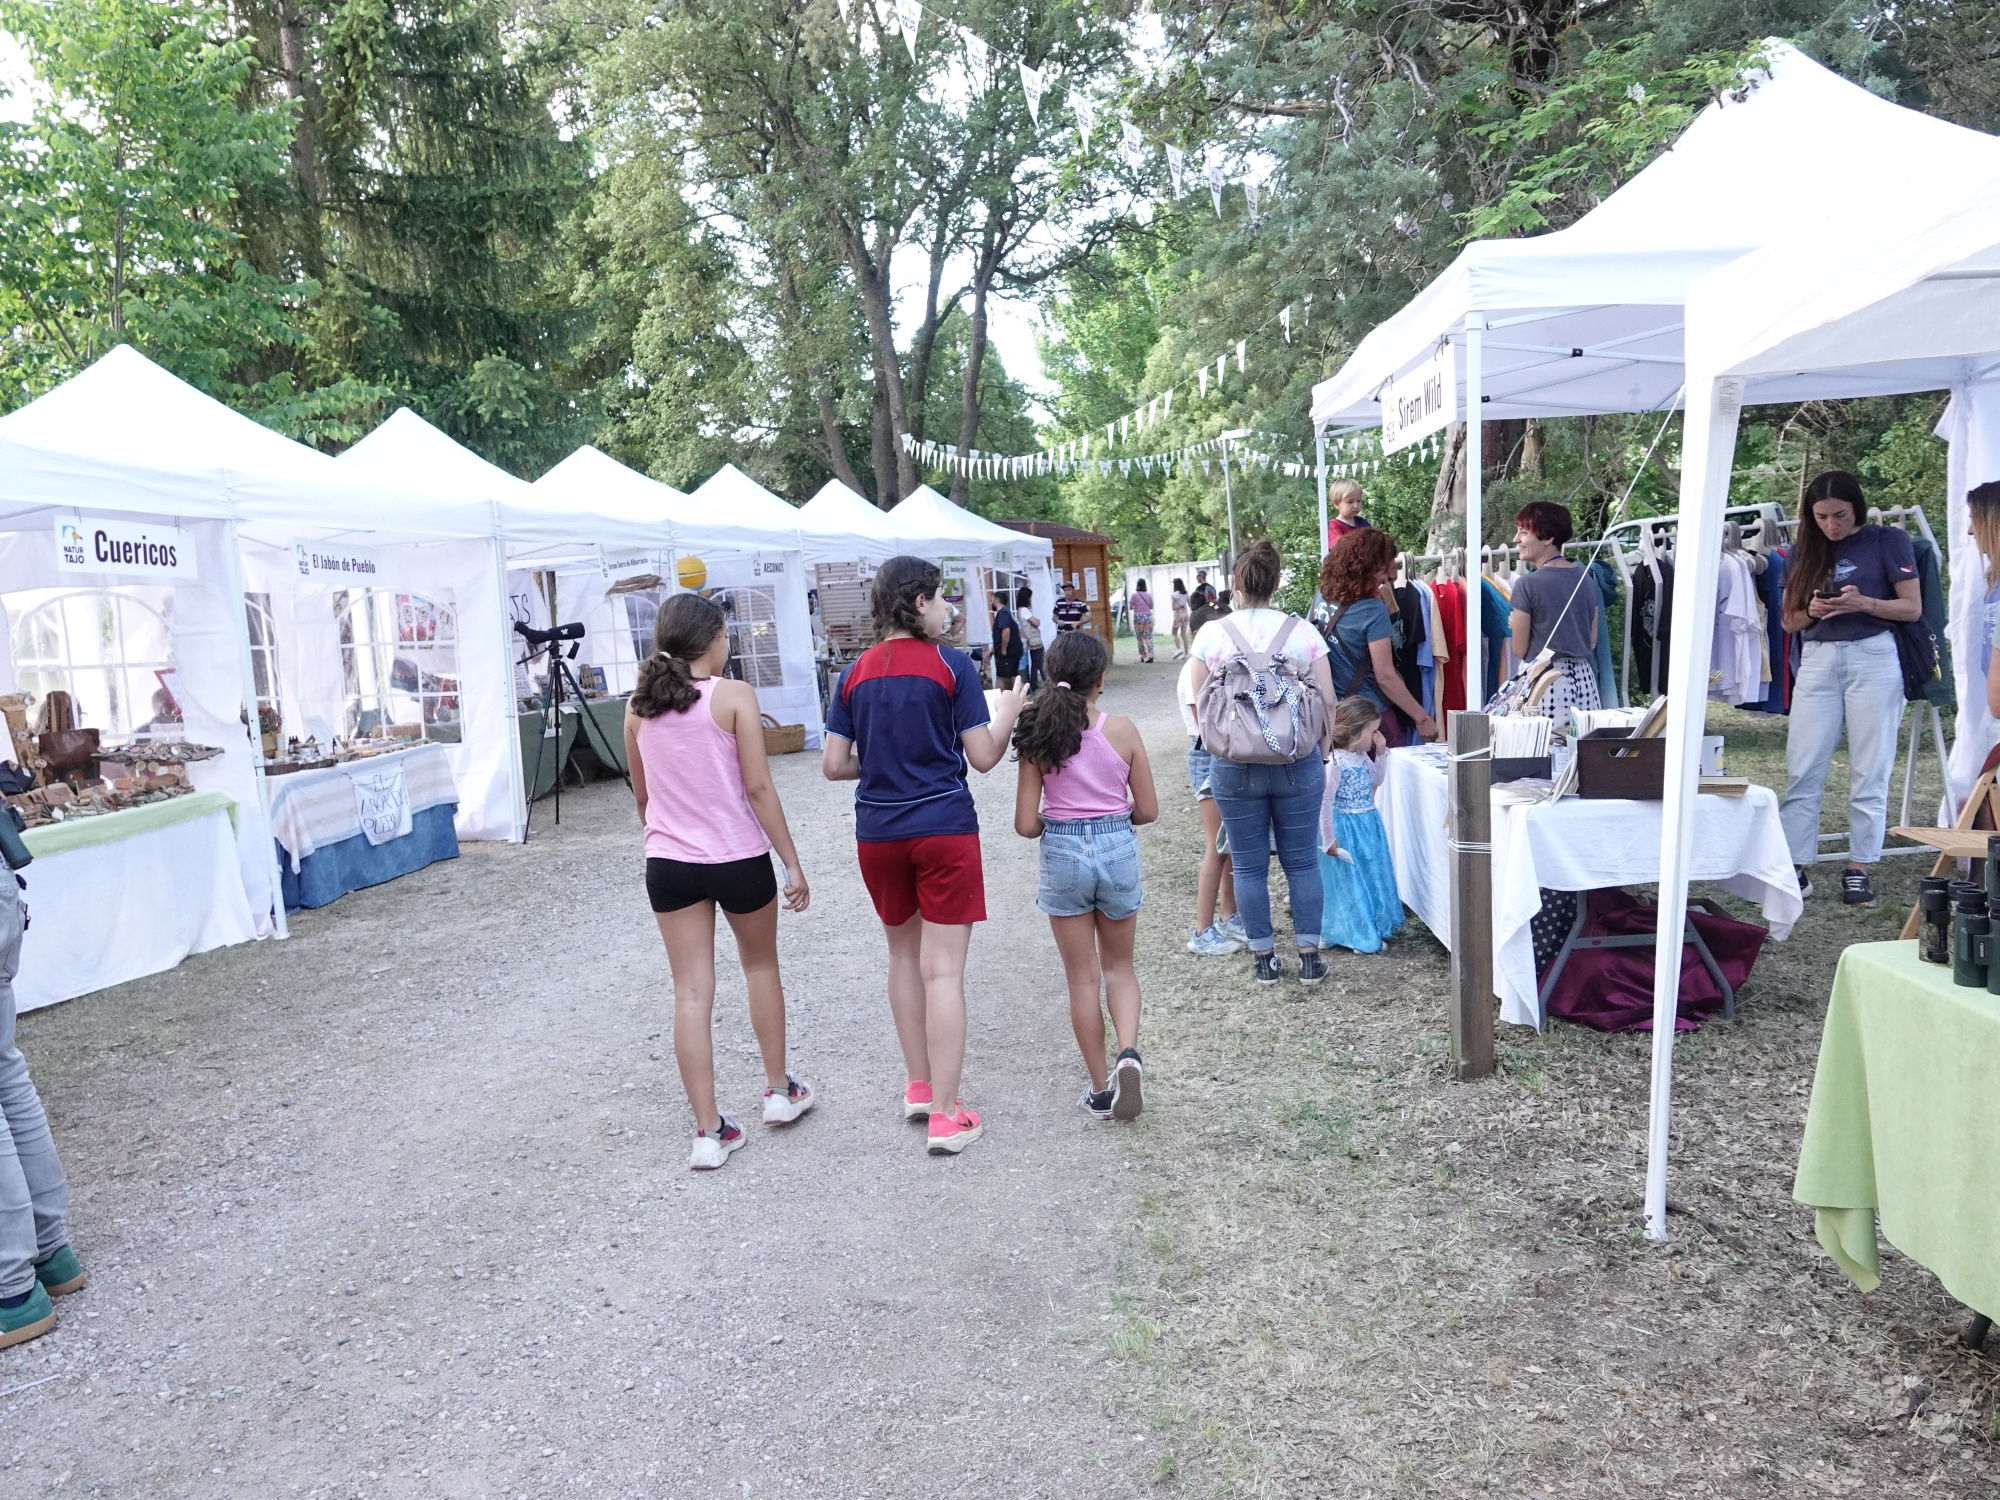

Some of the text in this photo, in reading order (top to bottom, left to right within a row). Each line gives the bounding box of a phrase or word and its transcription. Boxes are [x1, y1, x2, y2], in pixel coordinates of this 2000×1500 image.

[1399, 372, 1442, 431] Sirem Wild
[63, 545, 84, 554] NATUR
[95, 530, 177, 567] Cuericos
[65, 554, 85, 564] TAJO
[312, 553, 376, 574] El Jabón de Pueblo
[373, 774, 389, 792] EL
